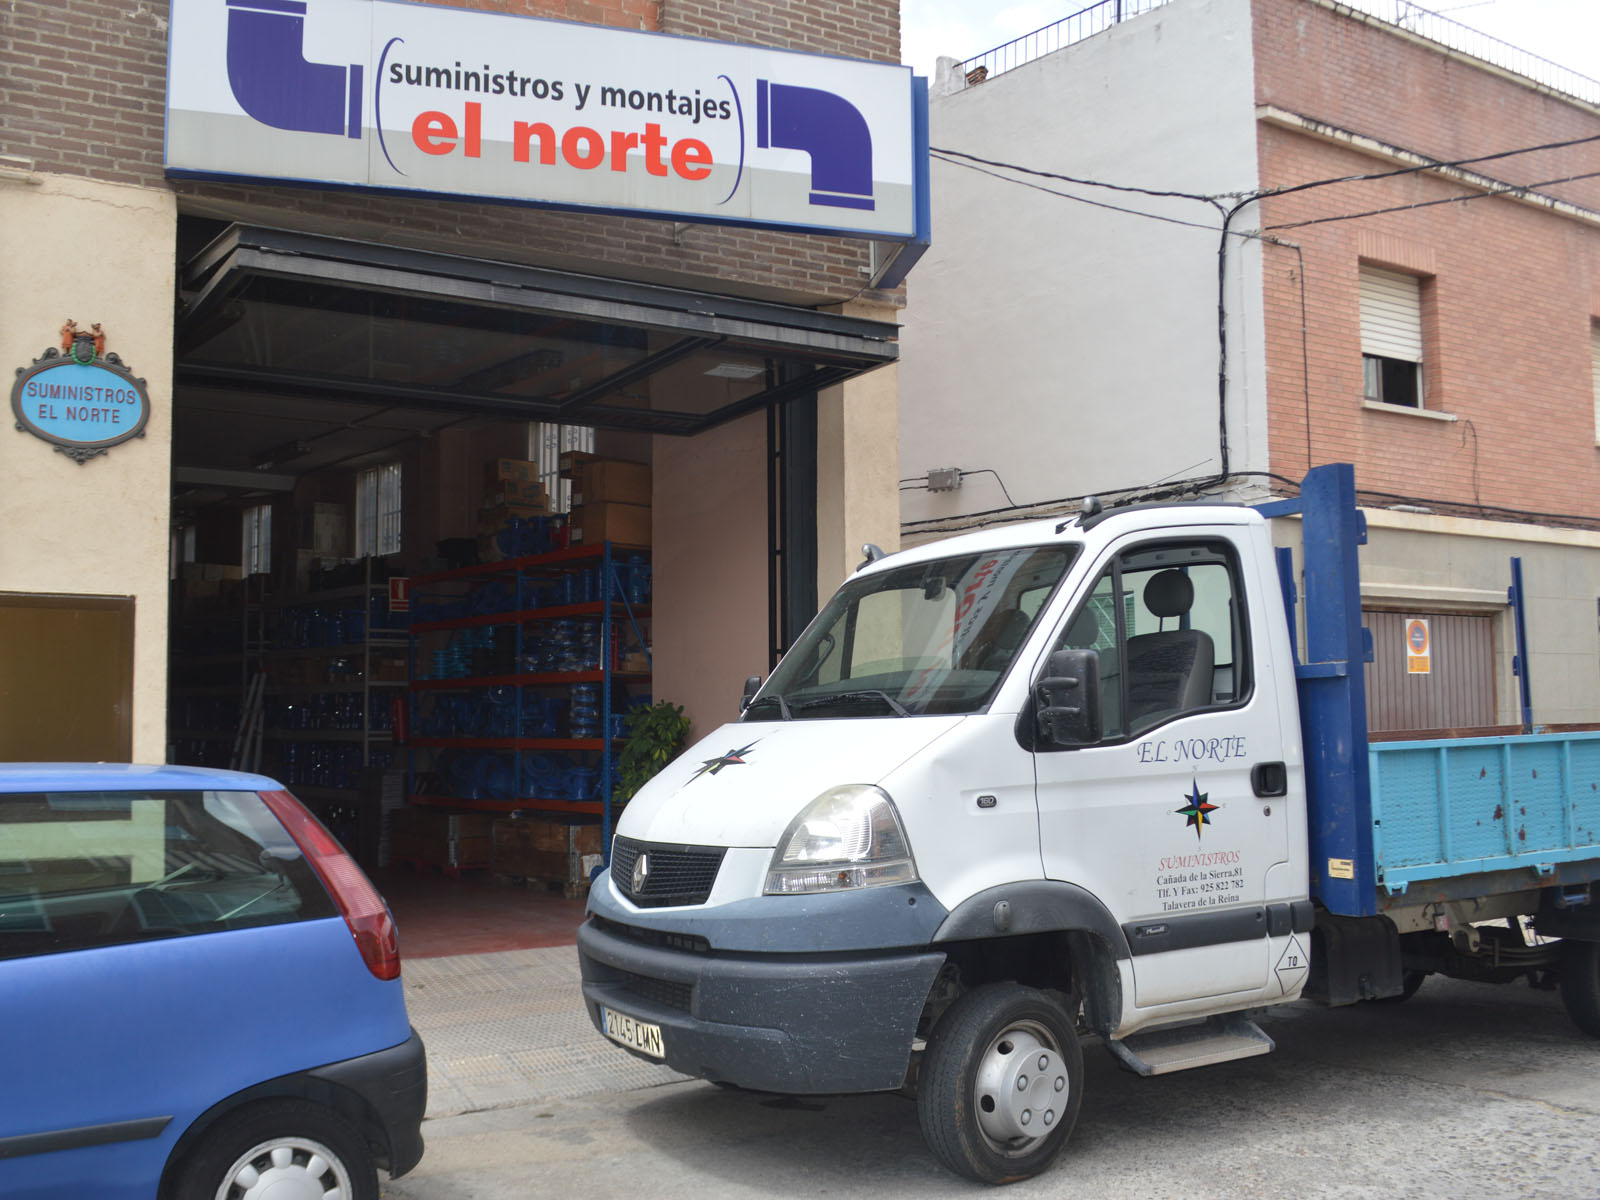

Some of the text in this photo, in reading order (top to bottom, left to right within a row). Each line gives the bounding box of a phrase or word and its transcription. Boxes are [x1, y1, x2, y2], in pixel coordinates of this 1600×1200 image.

[390, 61, 732, 124] suministros y montajes
[411, 101, 714, 181] el norte
[27, 381, 136, 405] SUMINISTROS
[38, 403, 120, 424] EL NORTE
[1137, 735, 1247, 763] EL NORTE
[1158, 850, 1241, 871] SUMINISTROS
[1156, 873, 1187, 886] Cañada
[1189, 871, 1199, 882] de
[1200, 871, 1208, 880] la
[1172, 887, 1180, 897] Y
[1181, 885, 1199, 896] Fax:
[1200, 882, 1215, 893] 925
[1215, 880, 1230, 891] 822
[1231, 879, 1244, 889] 782
[1162, 893, 1240, 912] Talavera de la Reina
[607, 1011, 633, 1043] 2145
